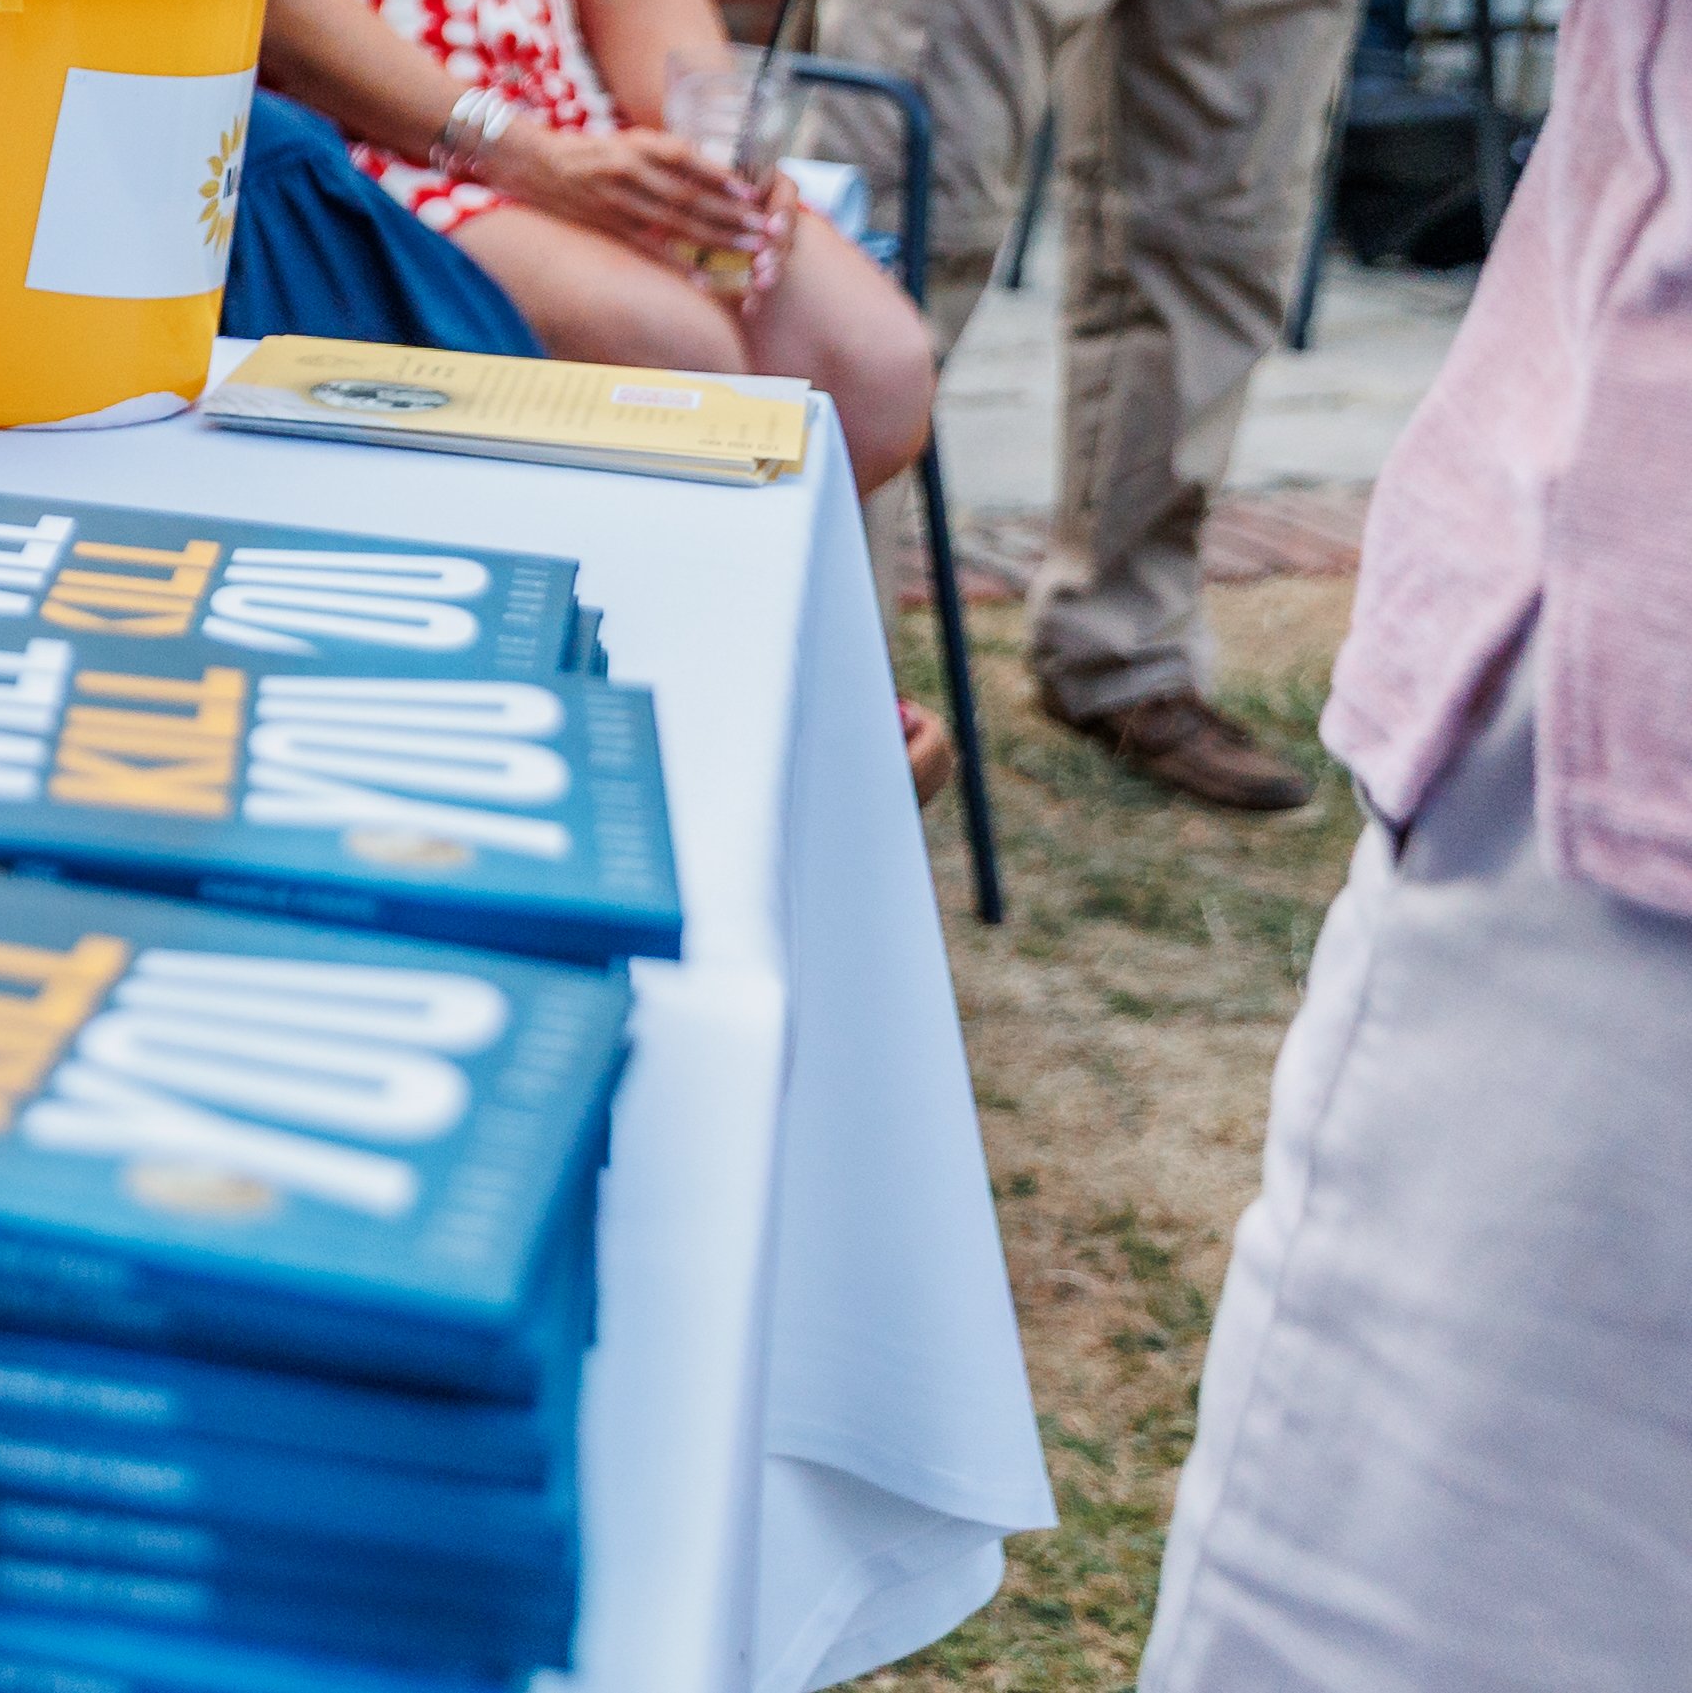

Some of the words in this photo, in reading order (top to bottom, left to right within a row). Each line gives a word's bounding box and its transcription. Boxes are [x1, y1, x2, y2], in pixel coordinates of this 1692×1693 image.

[47, 668, 246, 818] KILL
[241, 675, 571, 860] YOU
[18, 949, 511, 1218] YOU
